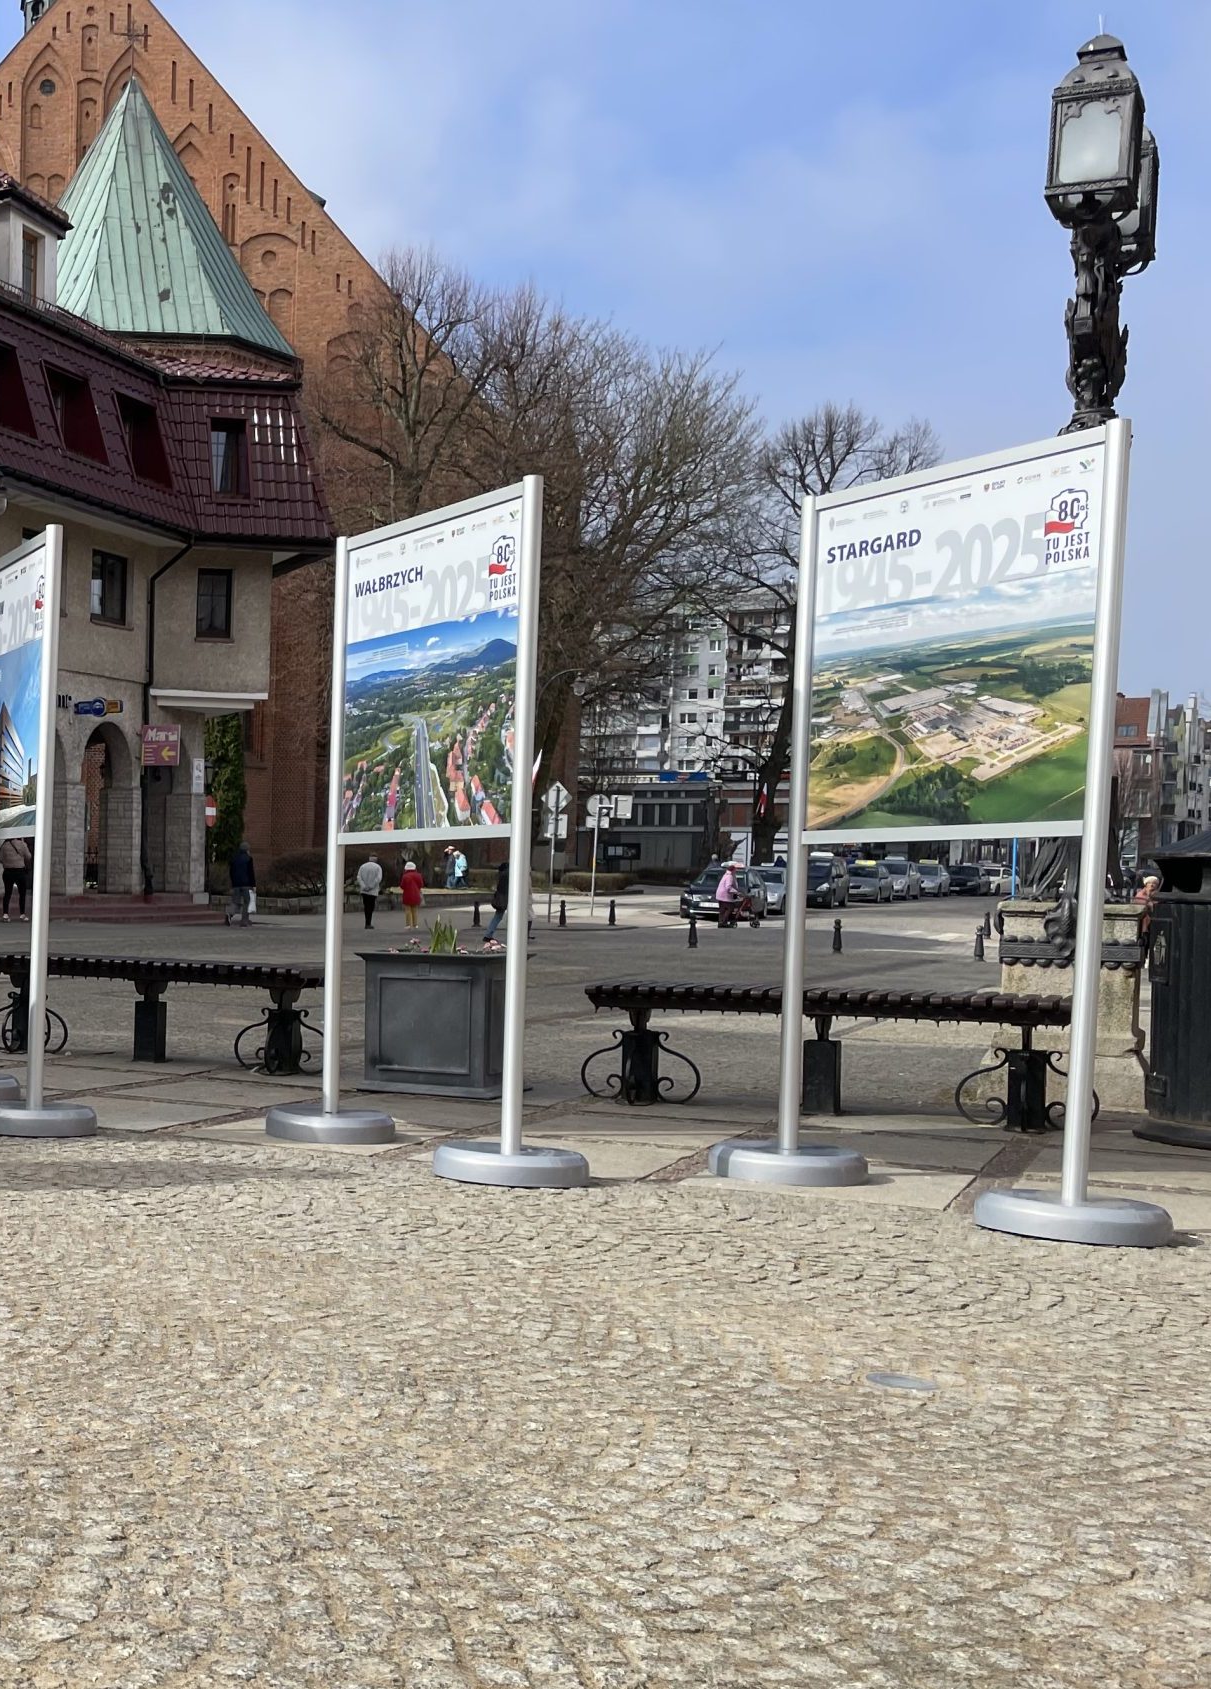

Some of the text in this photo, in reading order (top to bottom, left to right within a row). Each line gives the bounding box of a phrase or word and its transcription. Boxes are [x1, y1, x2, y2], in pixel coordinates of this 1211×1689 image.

[827, 529, 922, 564] STARGARD
[1046, 531, 1090, 551] TU JEST
[1045, 546, 1090, 565] POLSKA
[354, 565, 424, 598] WAŁBRZYCH
[490, 573, 517, 590] TU JEST
[489, 586, 517, 601] POLSKA
